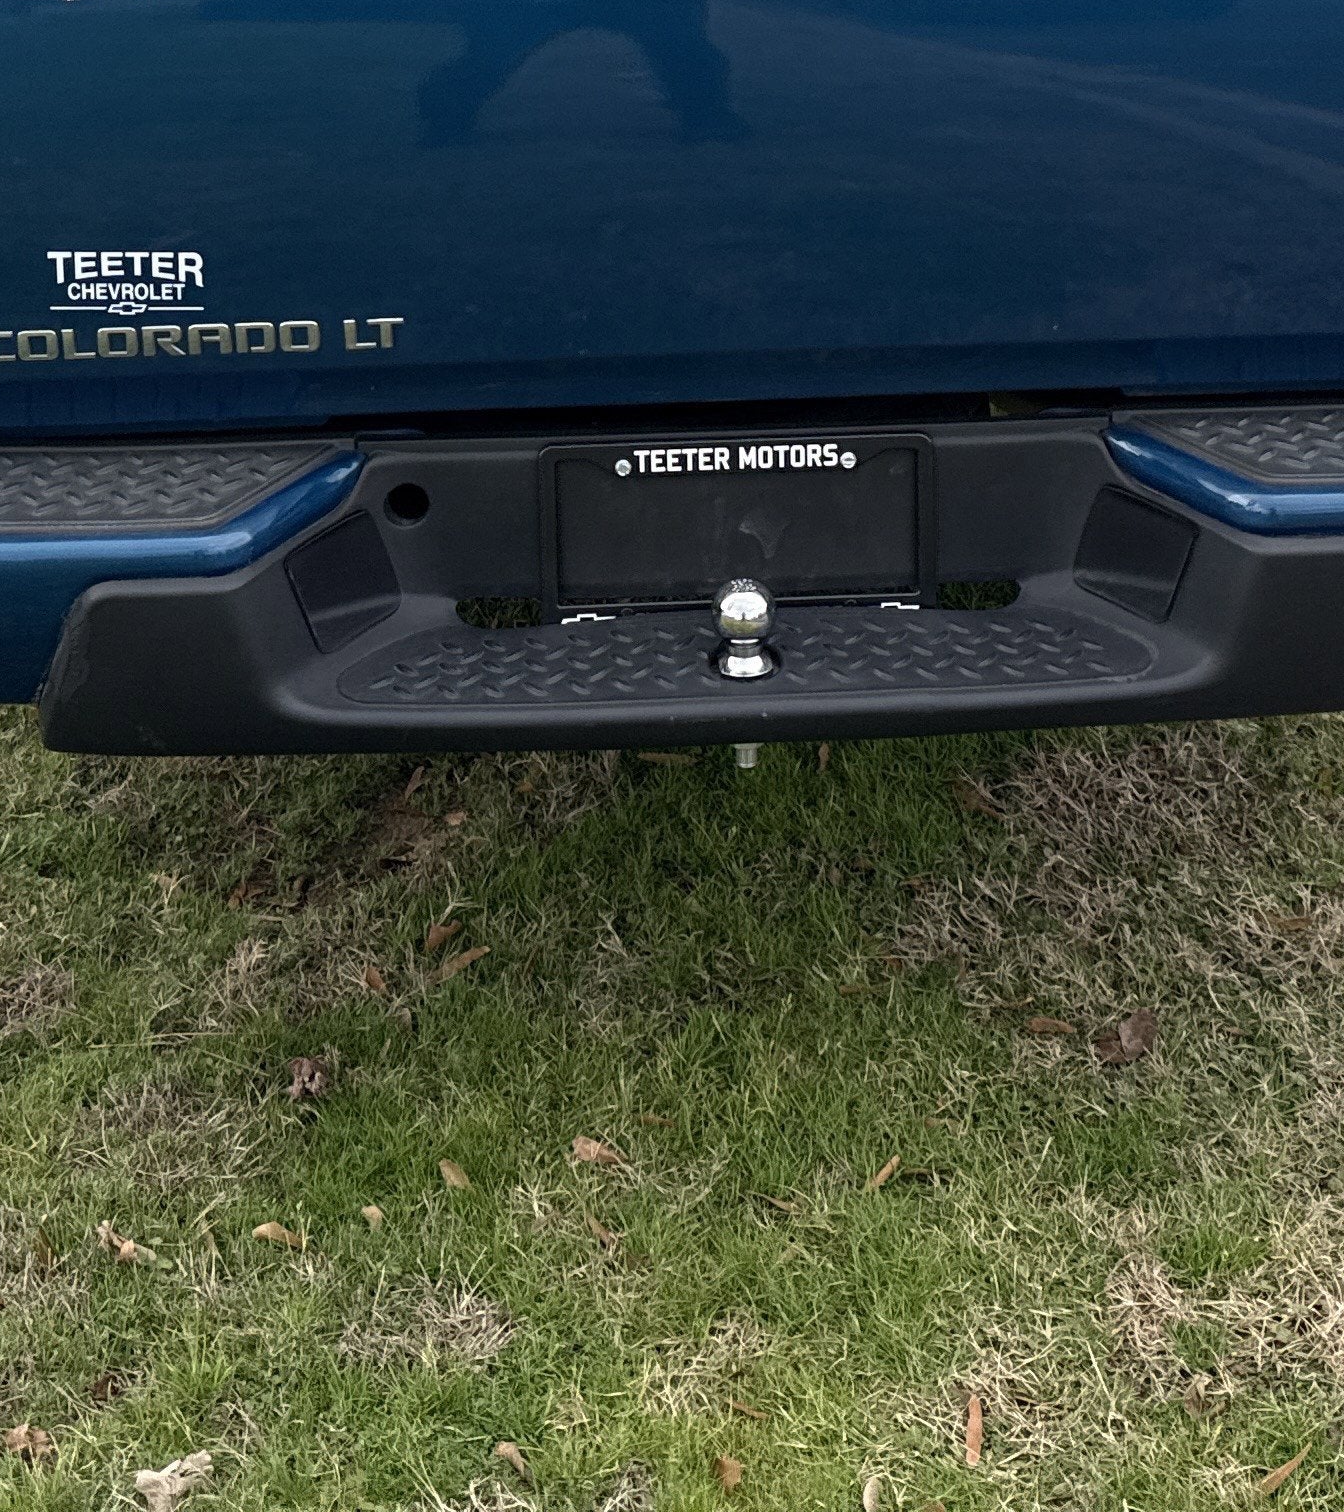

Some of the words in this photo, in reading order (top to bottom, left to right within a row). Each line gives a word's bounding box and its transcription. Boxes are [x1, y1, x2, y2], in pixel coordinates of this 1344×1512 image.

[46, 251, 204, 287] TEETER
[68, 282, 185, 300] CHEVROLET
[343, 317, 404, 350] LT
[633, 447, 730, 473] TEETER
[738, 444, 838, 469] MOTORS
